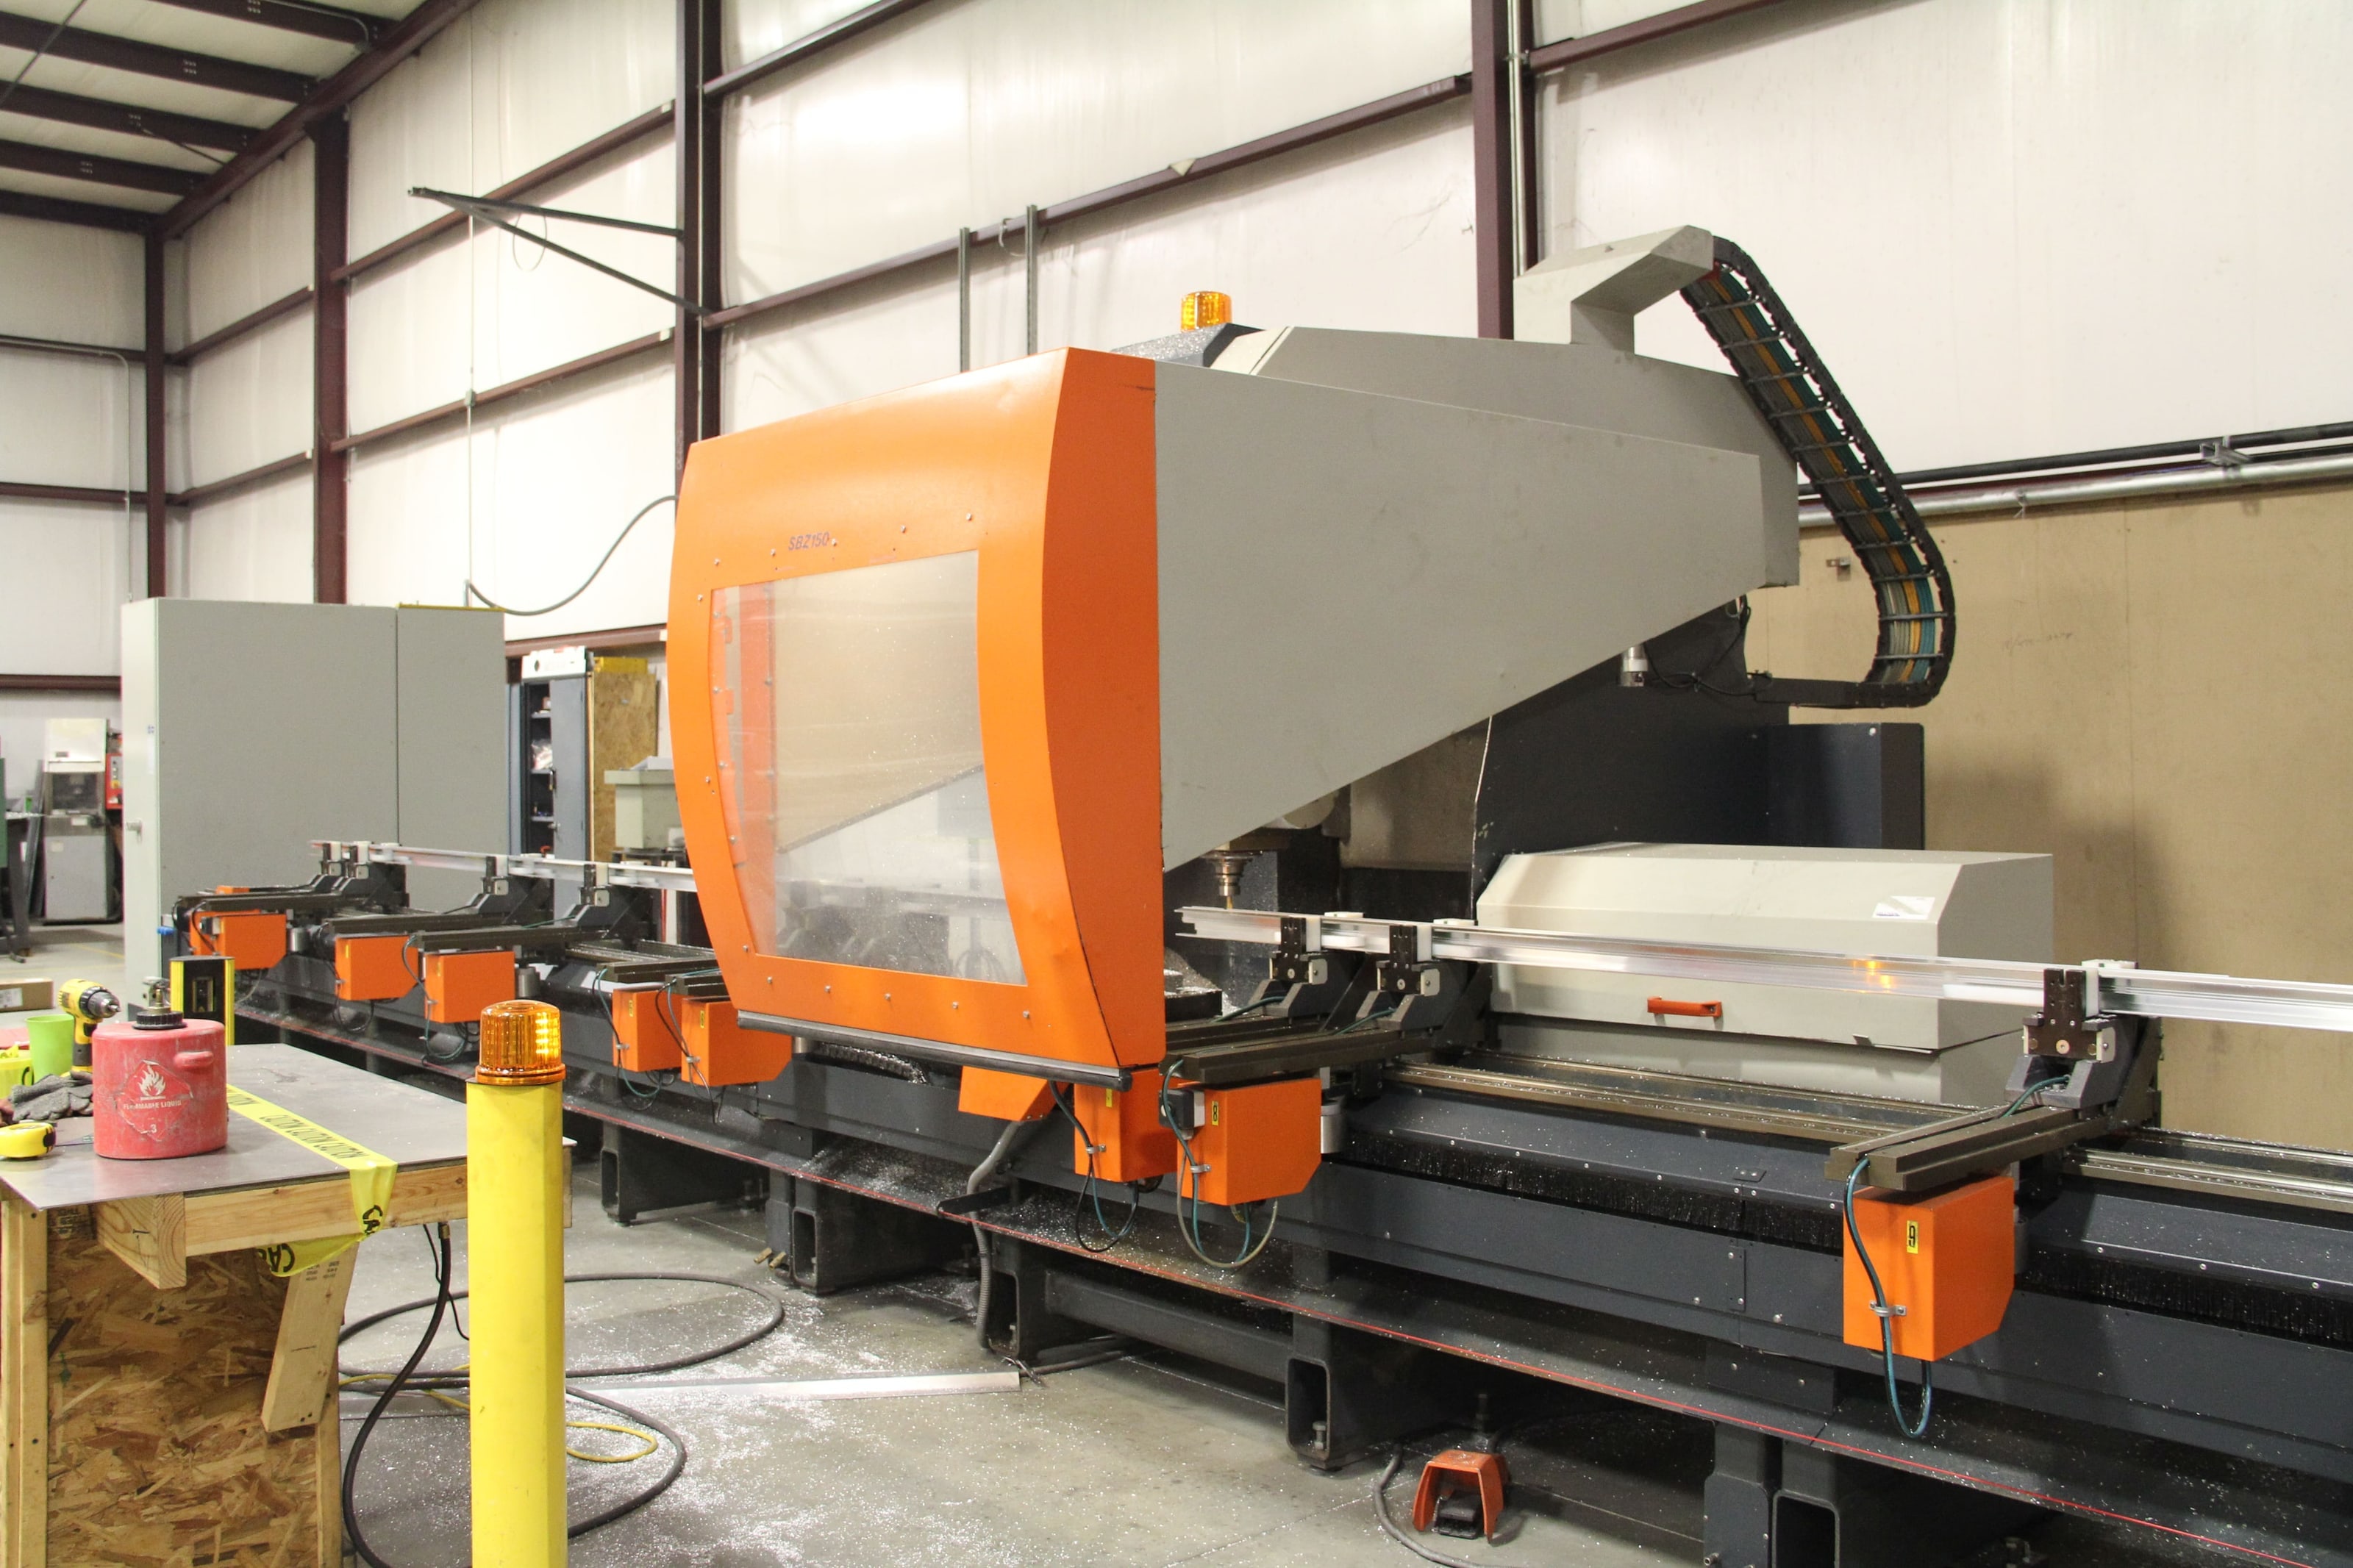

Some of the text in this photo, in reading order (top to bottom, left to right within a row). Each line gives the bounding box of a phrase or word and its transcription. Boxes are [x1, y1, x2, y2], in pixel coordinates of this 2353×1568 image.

[788, 531, 829, 551] SBZ150
[161, 1100, 182, 1108] LIQUID
[1213, 1104, 1218, 1122] 8
[150, 1124, 157, 1134] 3
[1908, 1225, 1916, 1248] 9
